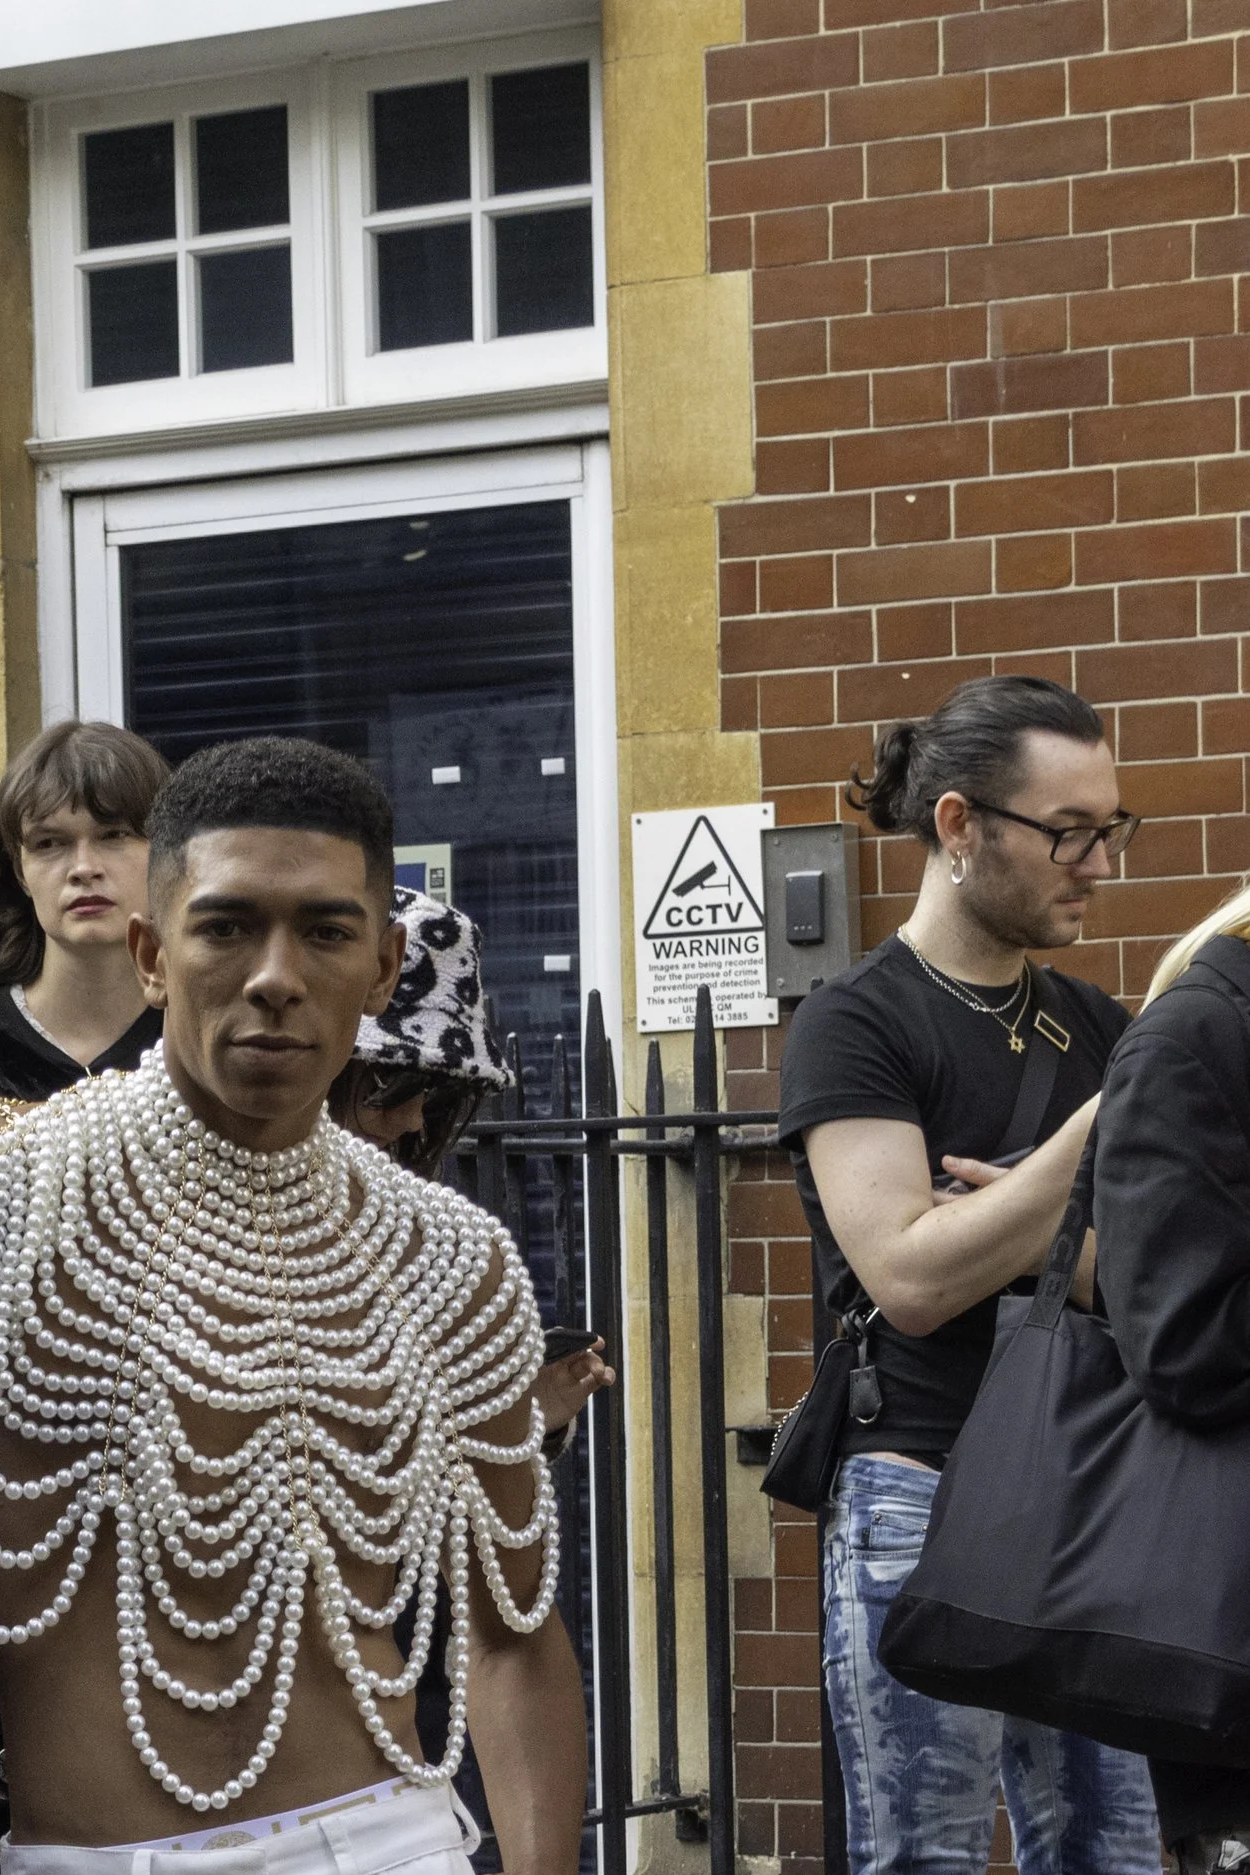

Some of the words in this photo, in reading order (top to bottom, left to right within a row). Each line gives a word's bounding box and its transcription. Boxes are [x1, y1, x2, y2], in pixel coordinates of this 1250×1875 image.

[665, 902, 744, 928] CCTV
[653, 935, 760, 959] WARNING
[648, 964, 680, 973] Images
[698, 960, 722, 969] being
[725, 957, 764, 967] recorded
[654, 973, 666, 981] for
[669, 973, 682, 981] the
[685, 971, 720, 982] purpose
[723, 969, 732, 977] of
[734, 968, 759, 977] crime
[653, 983, 698, 993] prevention
[704, 980, 718, 989] nd
[720, 978, 761, 988] detection
[646, 996, 665, 1005] This
[667, 995, 698, 1005] schem
[715, 991, 755, 1002] operated
[717, 1003, 732, 1012] QM
[667, 1015, 683, 1024] Tel:
[727, 1011, 749, 1021] 3885
